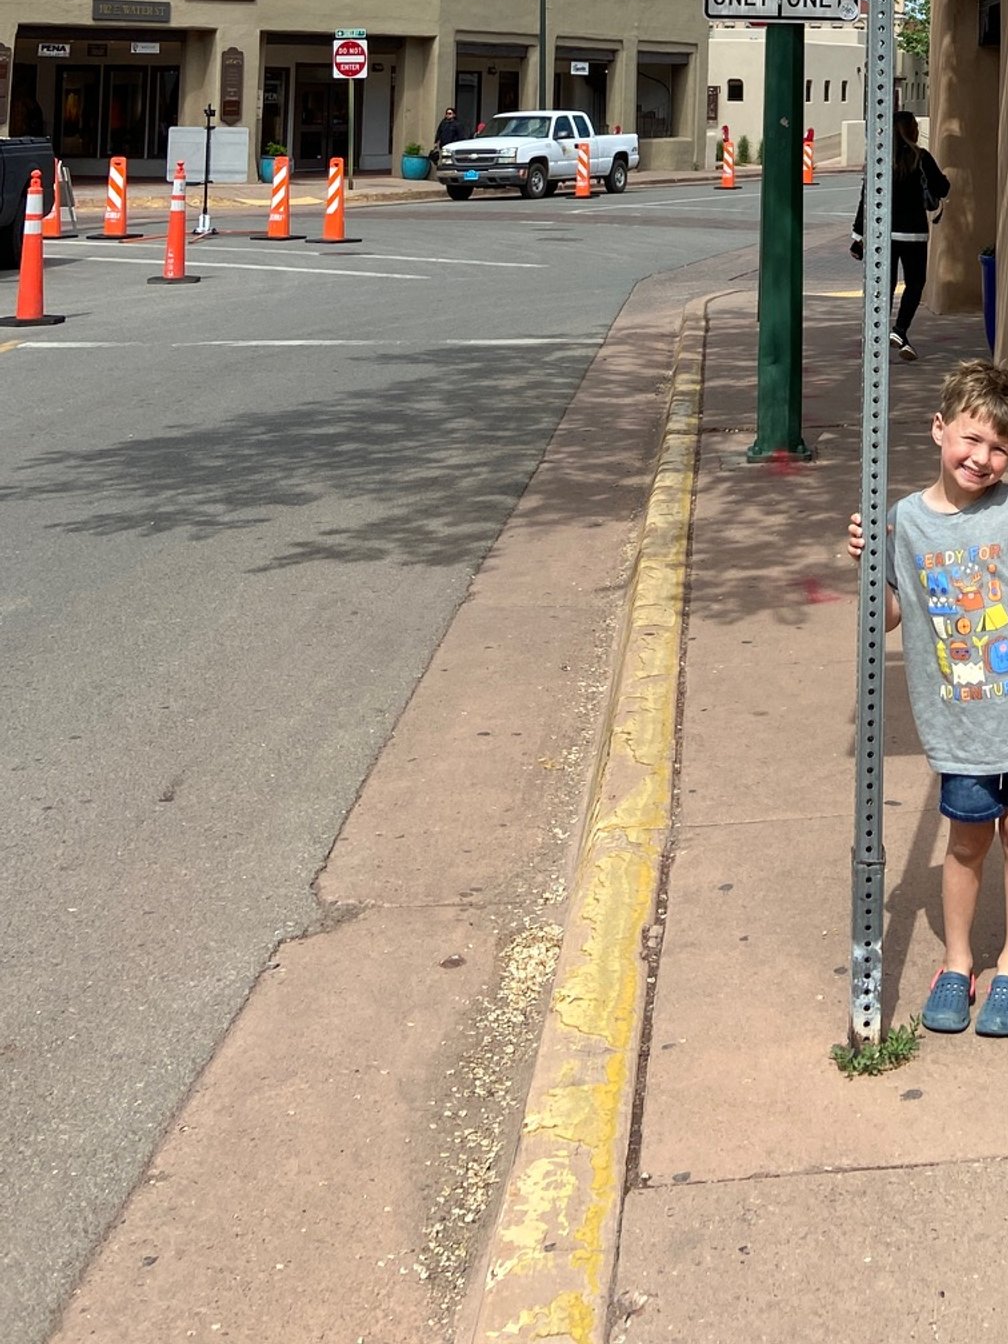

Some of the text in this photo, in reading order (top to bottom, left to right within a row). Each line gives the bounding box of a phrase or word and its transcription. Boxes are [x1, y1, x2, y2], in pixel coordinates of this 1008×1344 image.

[338, 47, 362, 55] DO NOT
[340, 63, 360, 71] ENTER
[915, 543, 1001, 570] READY FOR
